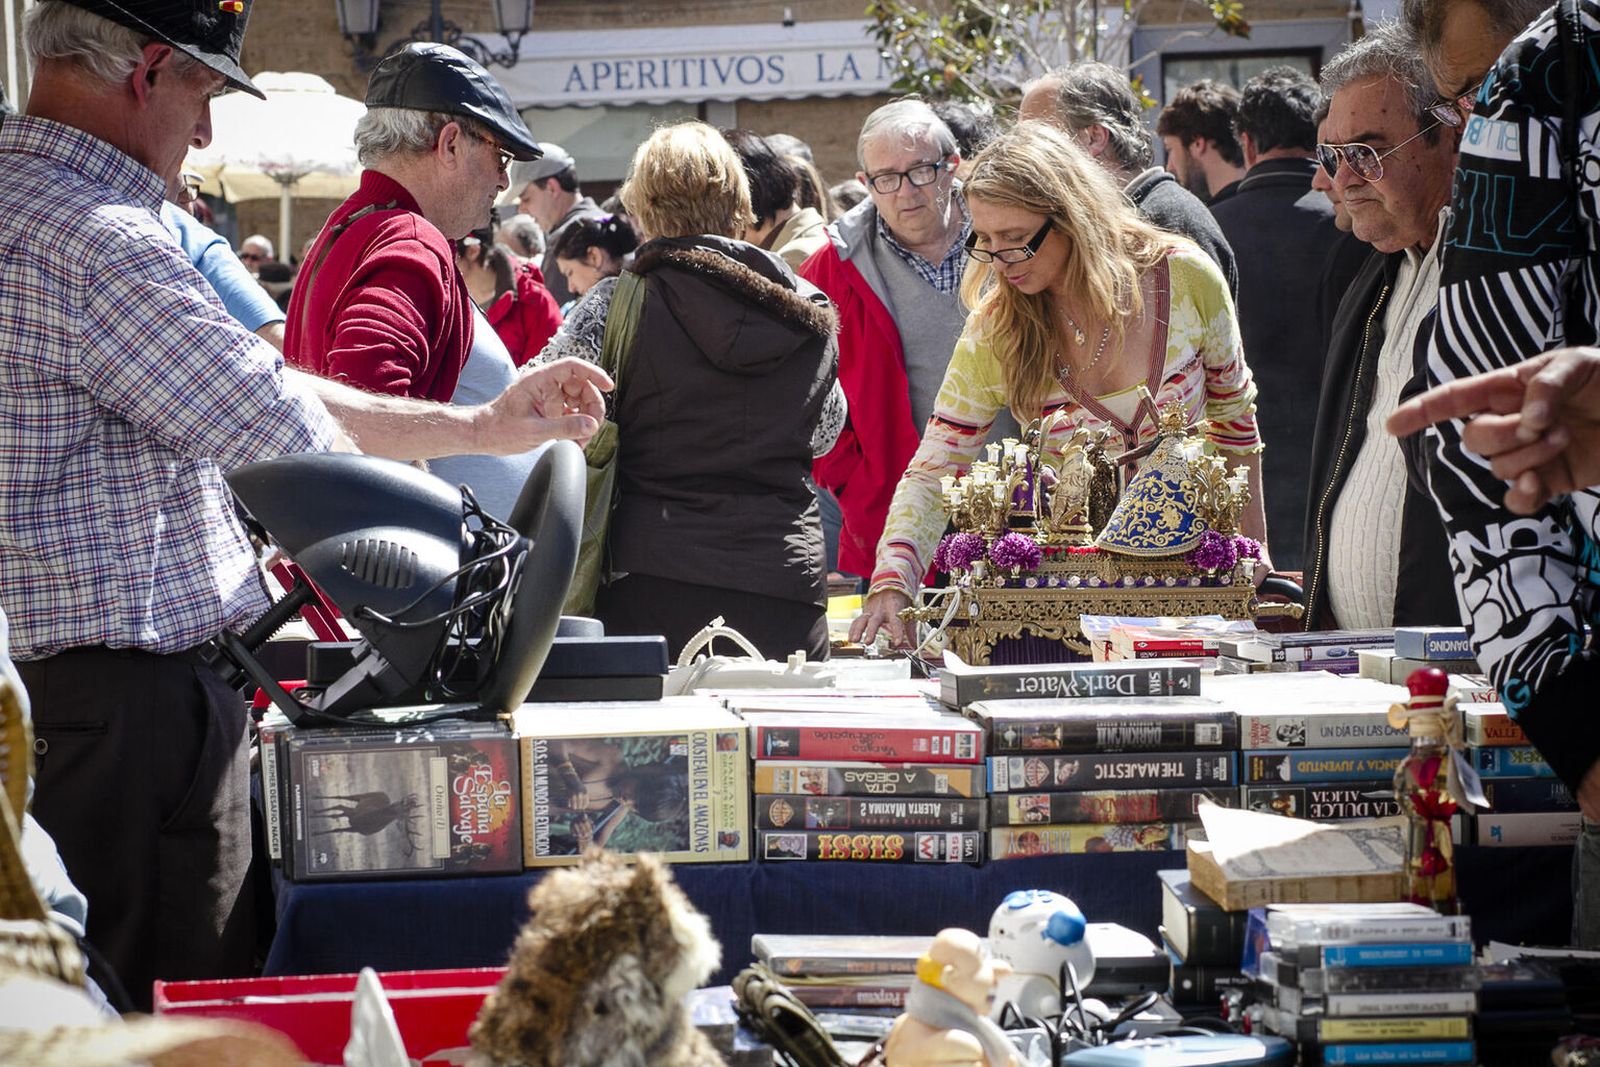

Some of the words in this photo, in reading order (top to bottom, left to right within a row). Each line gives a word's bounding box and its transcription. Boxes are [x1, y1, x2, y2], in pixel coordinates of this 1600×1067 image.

[563, 54, 785, 92] APERITIVOS
[816, 53, 862, 83] LA
[1429, 641, 1468, 652] DANCING
[1016, 671, 1081, 698] Water
[1081, 673, 1136, 697] Dark
[1150, 671, 1161, 694] VHS
[1320, 723, 1334, 737] UN
[1353, 724, 1363, 736] EN
[1365, 724, 1383, 736] LAS
[267, 748, 275, 757] EL
[693, 732, 708, 775] COUSTEAU
[268, 759, 277, 788] PRIMER
[1094, 762, 1160, 780] MAJESTIC
[1161, 761, 1185, 777] THE
[1297, 761, 1354, 774] JUVENTUD
[1357, 761, 1364, 772] Y
[1367, 760, 1400, 772] ENCIA
[694, 779, 708, 789] EN
[844, 772, 899, 783] CIEGAS
[904, 773, 916, 782] A
[492, 779, 512, 808] La
[535, 776, 549, 804] MUNDO
[694, 791, 708, 801] EL
[865, 783, 896, 793] CITA
[1312, 790, 1360, 802] ALICIA
[472, 764, 493, 835] España
[453, 776, 478, 845] Salvaje
[535, 805, 549, 815] EN
[860, 802, 867, 817] 2
[868, 802, 906, 818] MAXIMA
[908, 802, 941, 818] ALERTA
[1310, 802, 1368, 818] DULCE
[694, 804, 709, 853] AMAZONAS
[271, 826, 279, 853] NACER
[818, 833, 905, 860] SISSI
[964, 838, 973, 857] VHS
